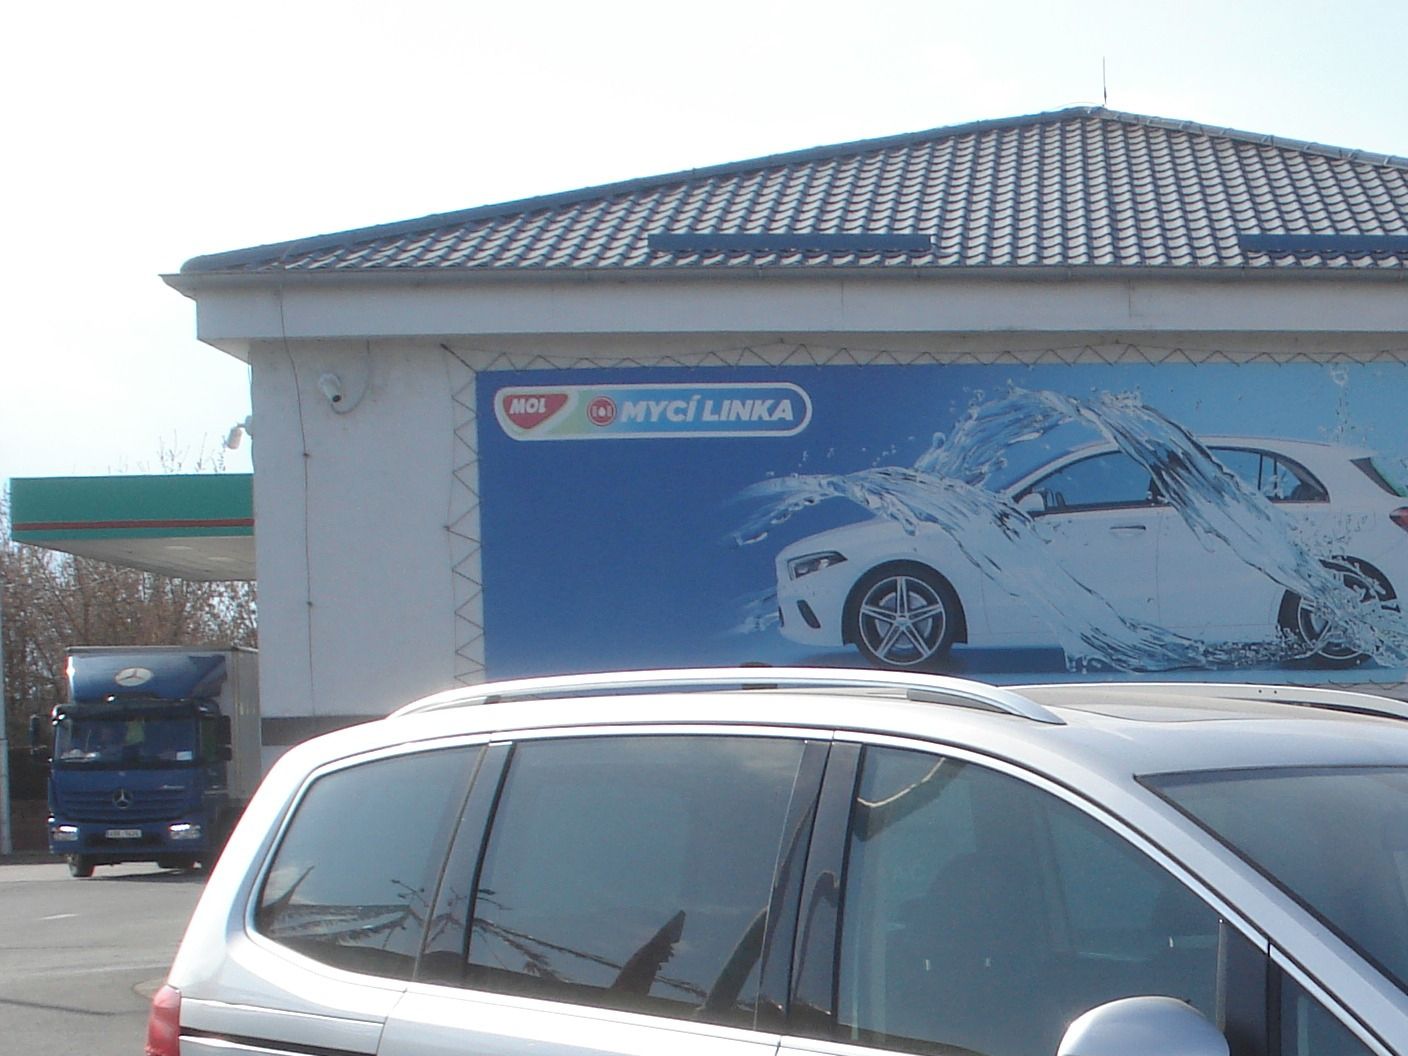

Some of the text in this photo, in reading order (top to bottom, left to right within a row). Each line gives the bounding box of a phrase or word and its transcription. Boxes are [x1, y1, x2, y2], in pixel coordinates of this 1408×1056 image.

[509, 397, 546, 415] MOL
[621, 394, 794, 422] MYCÍ LINKA
